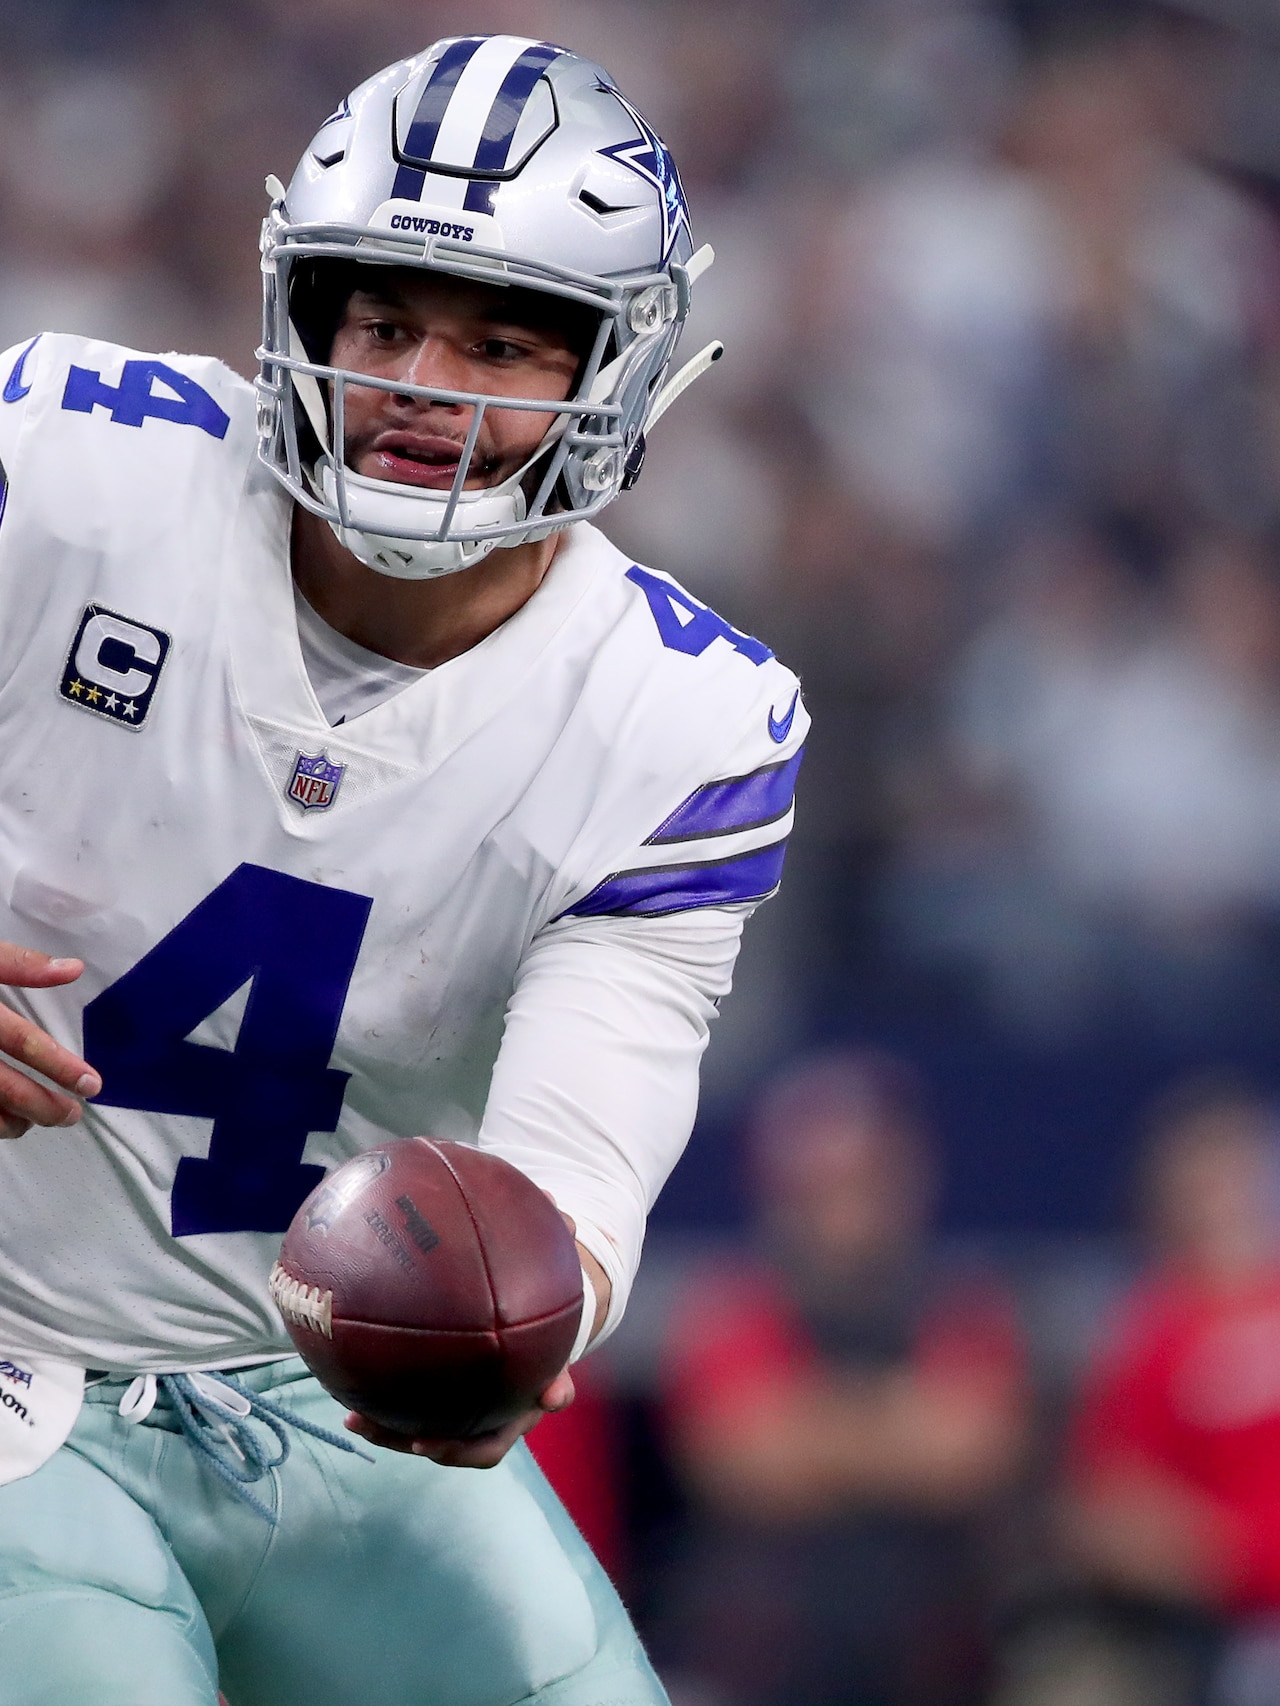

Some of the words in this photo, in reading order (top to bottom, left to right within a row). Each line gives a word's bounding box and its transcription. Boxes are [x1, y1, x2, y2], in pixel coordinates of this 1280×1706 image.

[390, 214, 475, 242] COWBOYS
[62, 359, 231, 440] 4
[73, 612, 161, 698] C
[624, 564, 776, 667] 4
[292, 774, 329, 804] NFL
[83, 861, 375, 1238] 4
